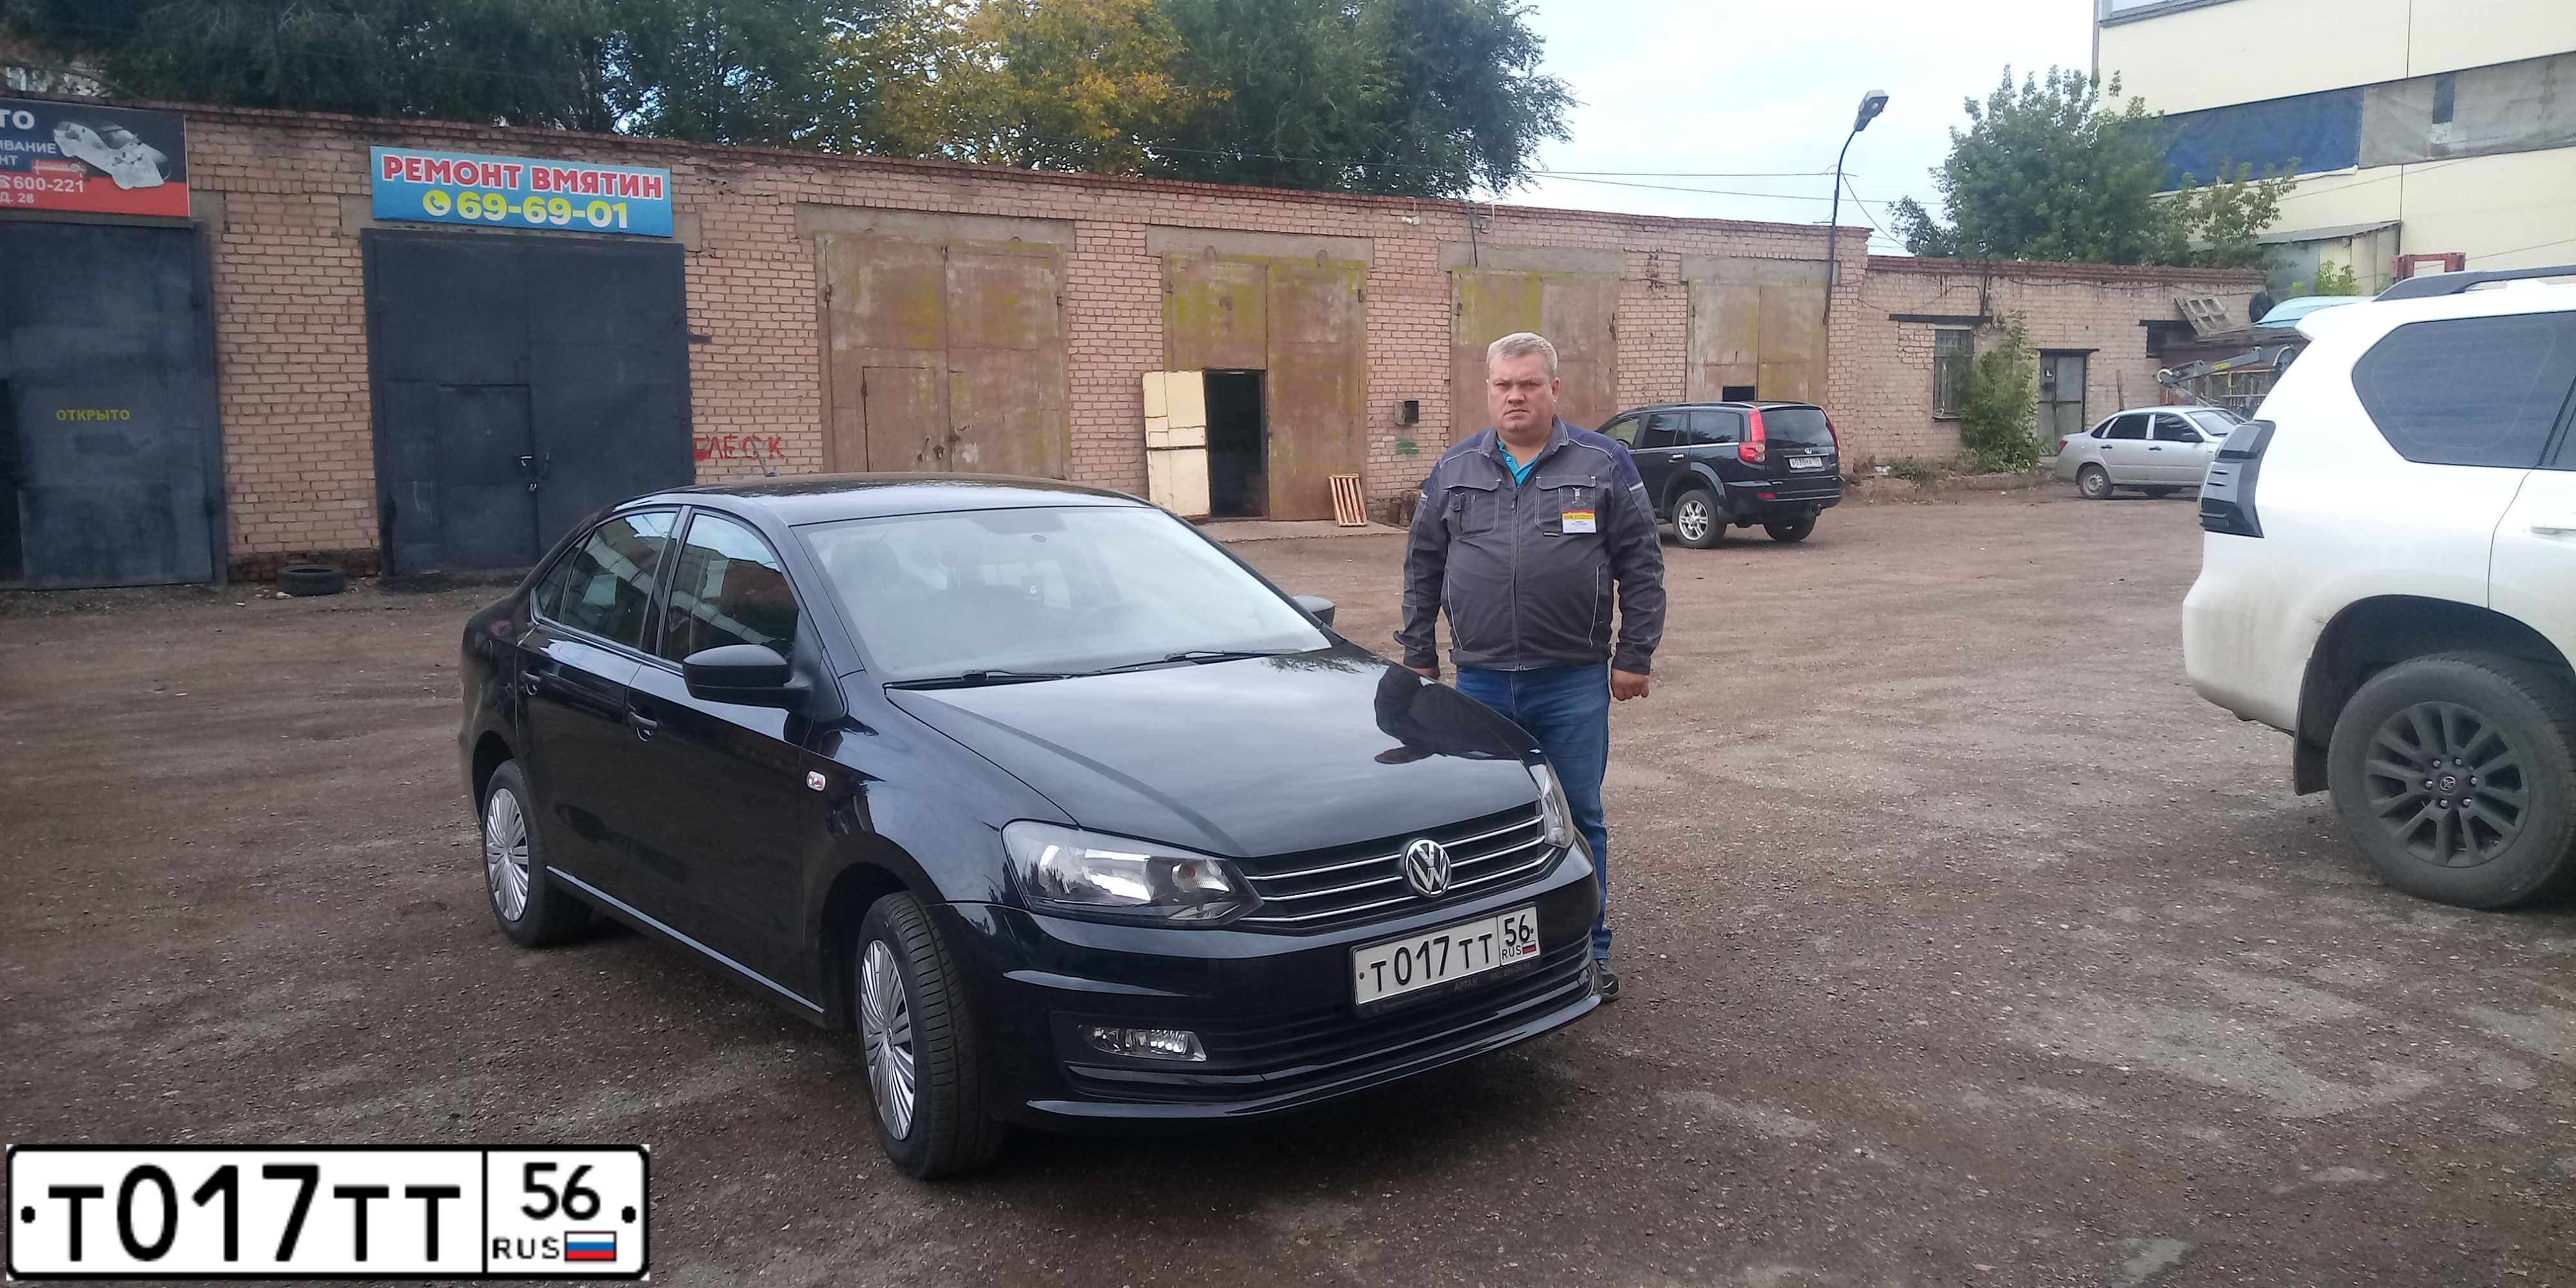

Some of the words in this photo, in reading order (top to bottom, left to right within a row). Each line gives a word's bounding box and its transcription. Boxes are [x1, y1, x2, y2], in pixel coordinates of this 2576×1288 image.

[0, 139, 57, 154] ВАНИЕ
[13, 176, 84, 193] 600-221
[382, 155, 521, 191] РЕМОНТ
[530, 166, 663, 199] ВМЯТИН
[17, 193, 34, 204] 28
[457, 191, 627, 229] 69-69-01
[56, 409, 131, 421] ОТКРЫТО
[1370, 933, 1492, 992] Т017ТТ
[1504, 914, 1531, 947] 56
[1501, 945, 1522, 960] RUS
